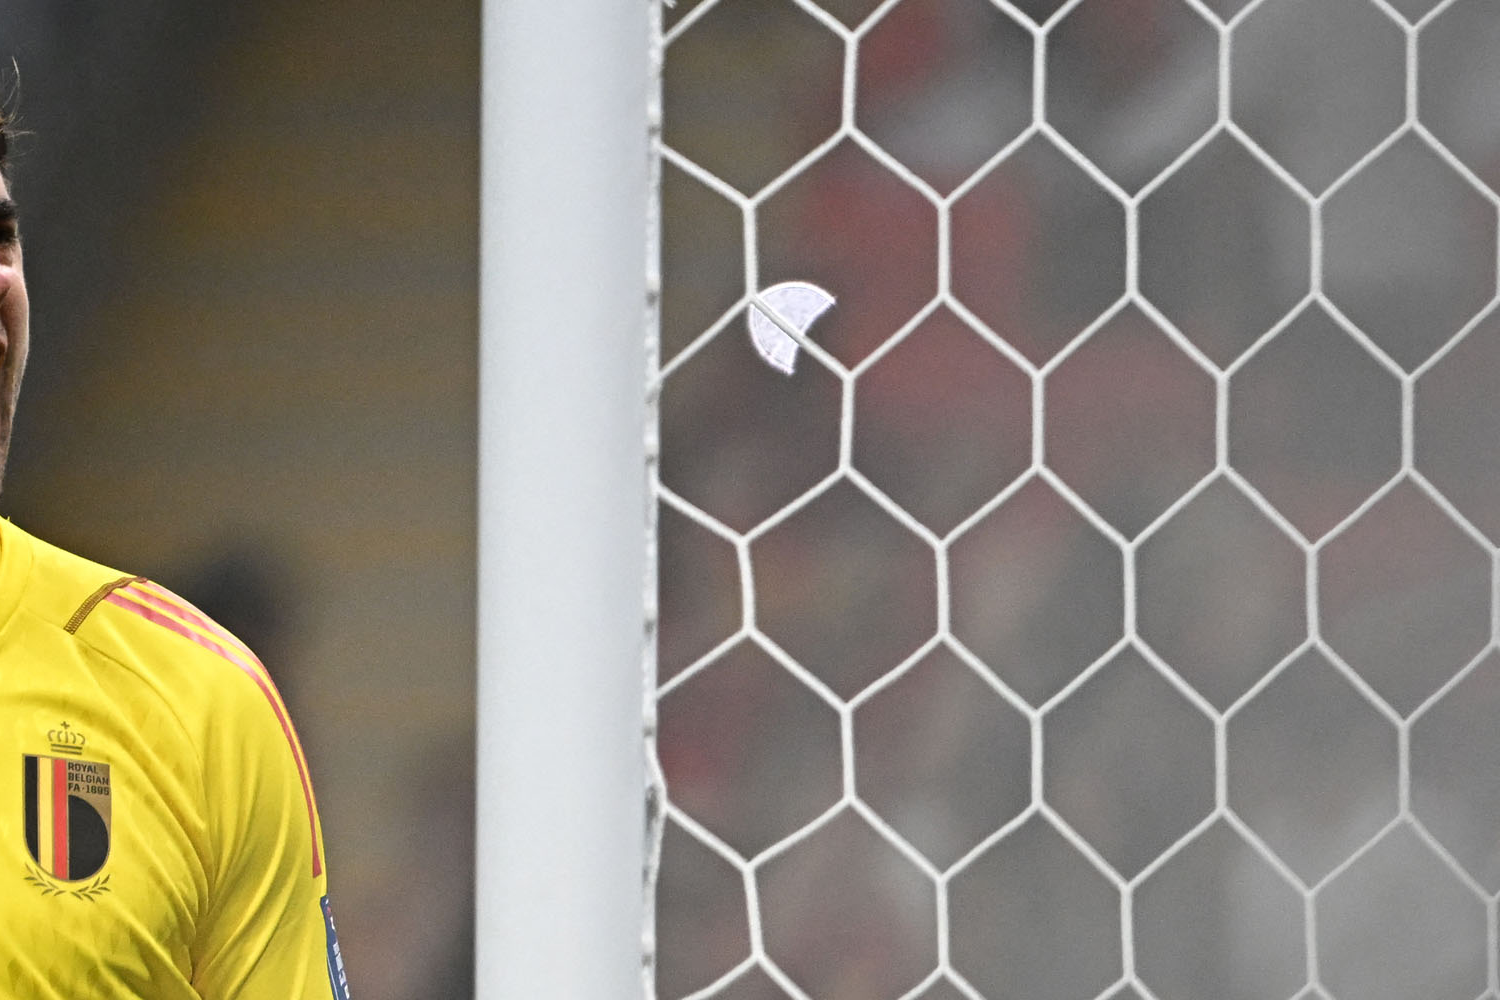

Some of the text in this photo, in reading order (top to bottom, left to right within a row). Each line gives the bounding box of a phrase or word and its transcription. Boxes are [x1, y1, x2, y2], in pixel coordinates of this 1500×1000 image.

[68, 762, 98, 774] ROYAL
[68, 772, 109, 785] BELGIAN
[68, 783, 80, 792] FA
